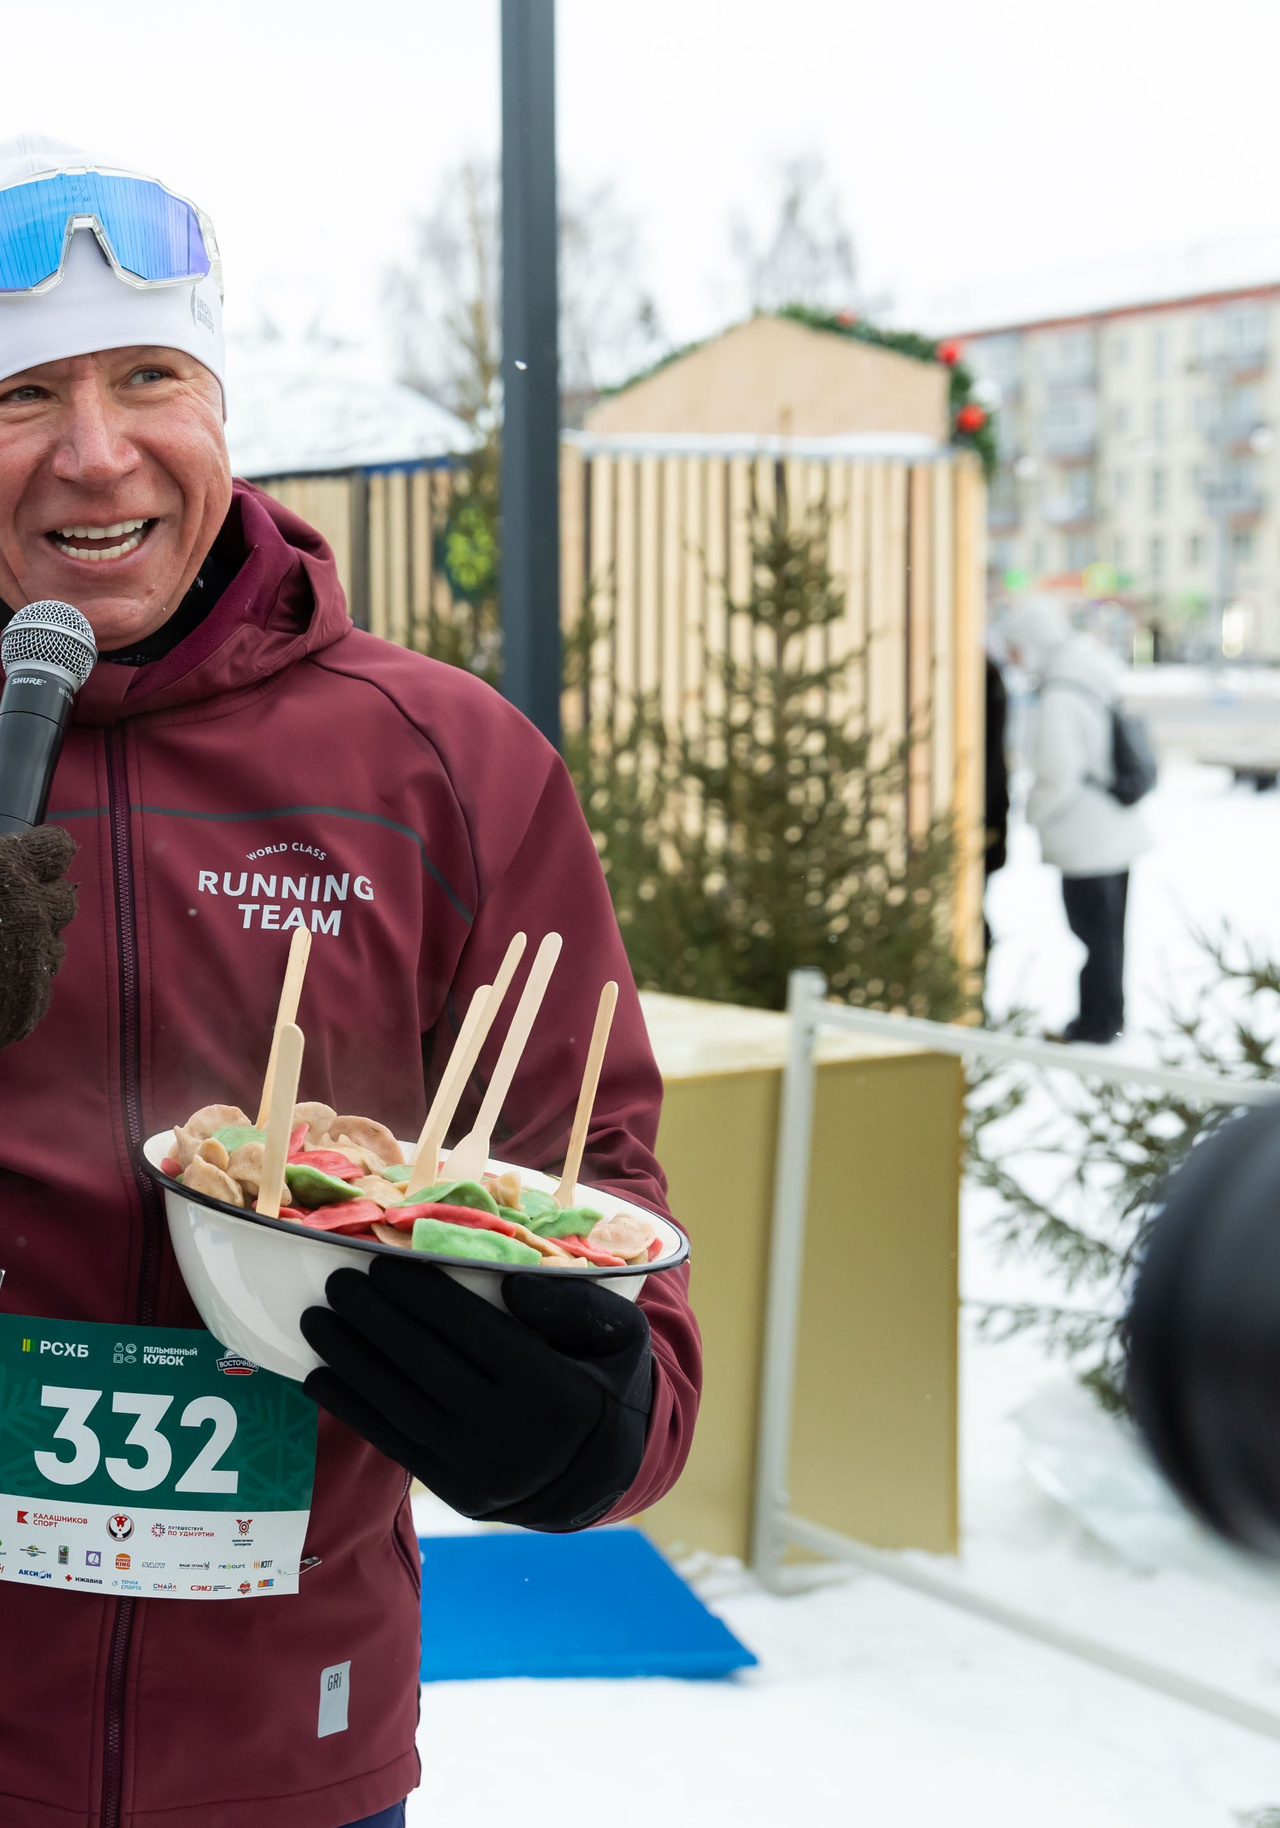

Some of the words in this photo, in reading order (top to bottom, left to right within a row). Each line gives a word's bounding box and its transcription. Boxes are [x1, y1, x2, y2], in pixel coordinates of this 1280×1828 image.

[11, 677, 44, 686] SHURE
[246, 842, 288, 861] WORLD
[291, 842, 327, 861] CLASS
[197, 870, 375, 903] RUNNING
[238, 903, 342, 937] TEAM
[40, 1340, 89, 1358] РСХБ
[143, 1345, 198, 1356] ПЕЛЬМЕННЫЙ
[143, 1354, 184, 1366] КУБОК
[34, 1385, 239, 1494] 332
[33, 1512, 88, 1525] КАЛАШНИКОВ
[33, 1519, 58, 1528] СПОРТ
